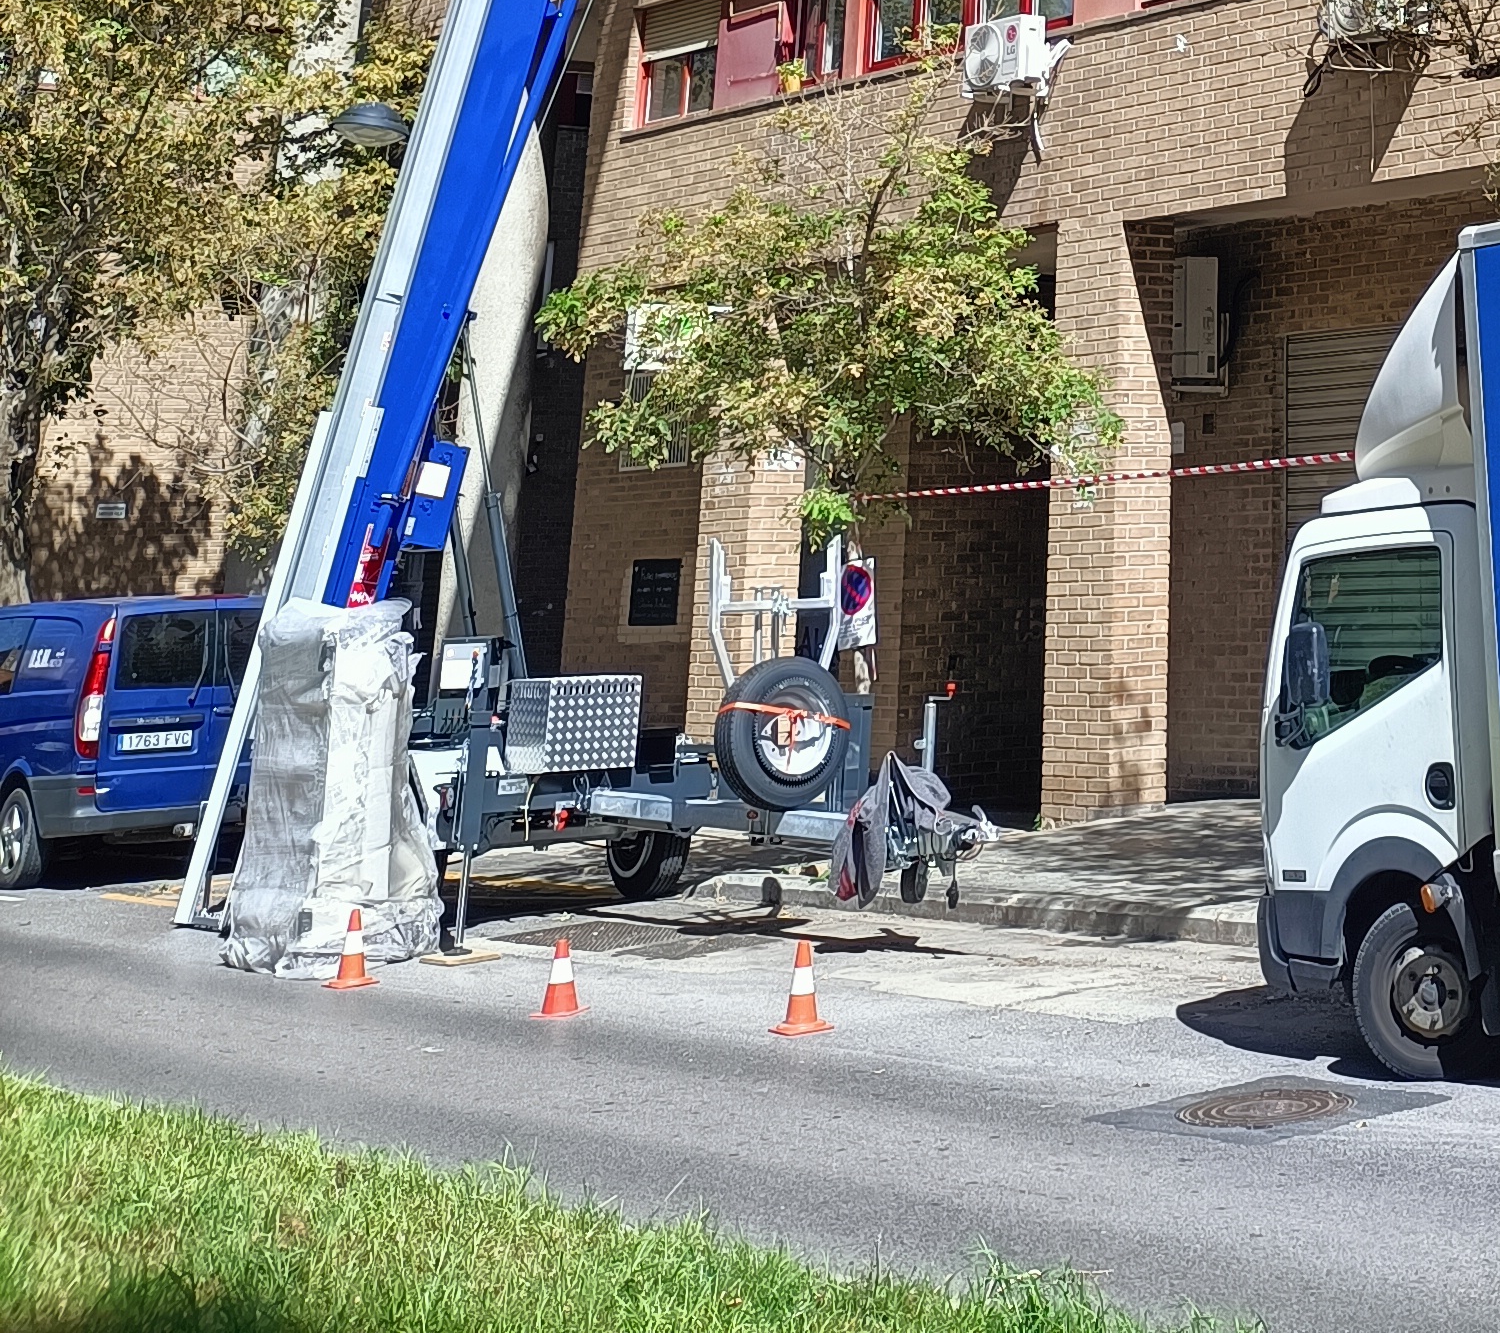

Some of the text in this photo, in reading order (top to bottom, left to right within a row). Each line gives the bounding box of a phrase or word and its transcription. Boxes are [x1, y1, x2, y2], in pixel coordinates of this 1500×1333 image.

[1006, 44, 1016, 56] LG
[129, 732, 191, 748] 1763 FVC
